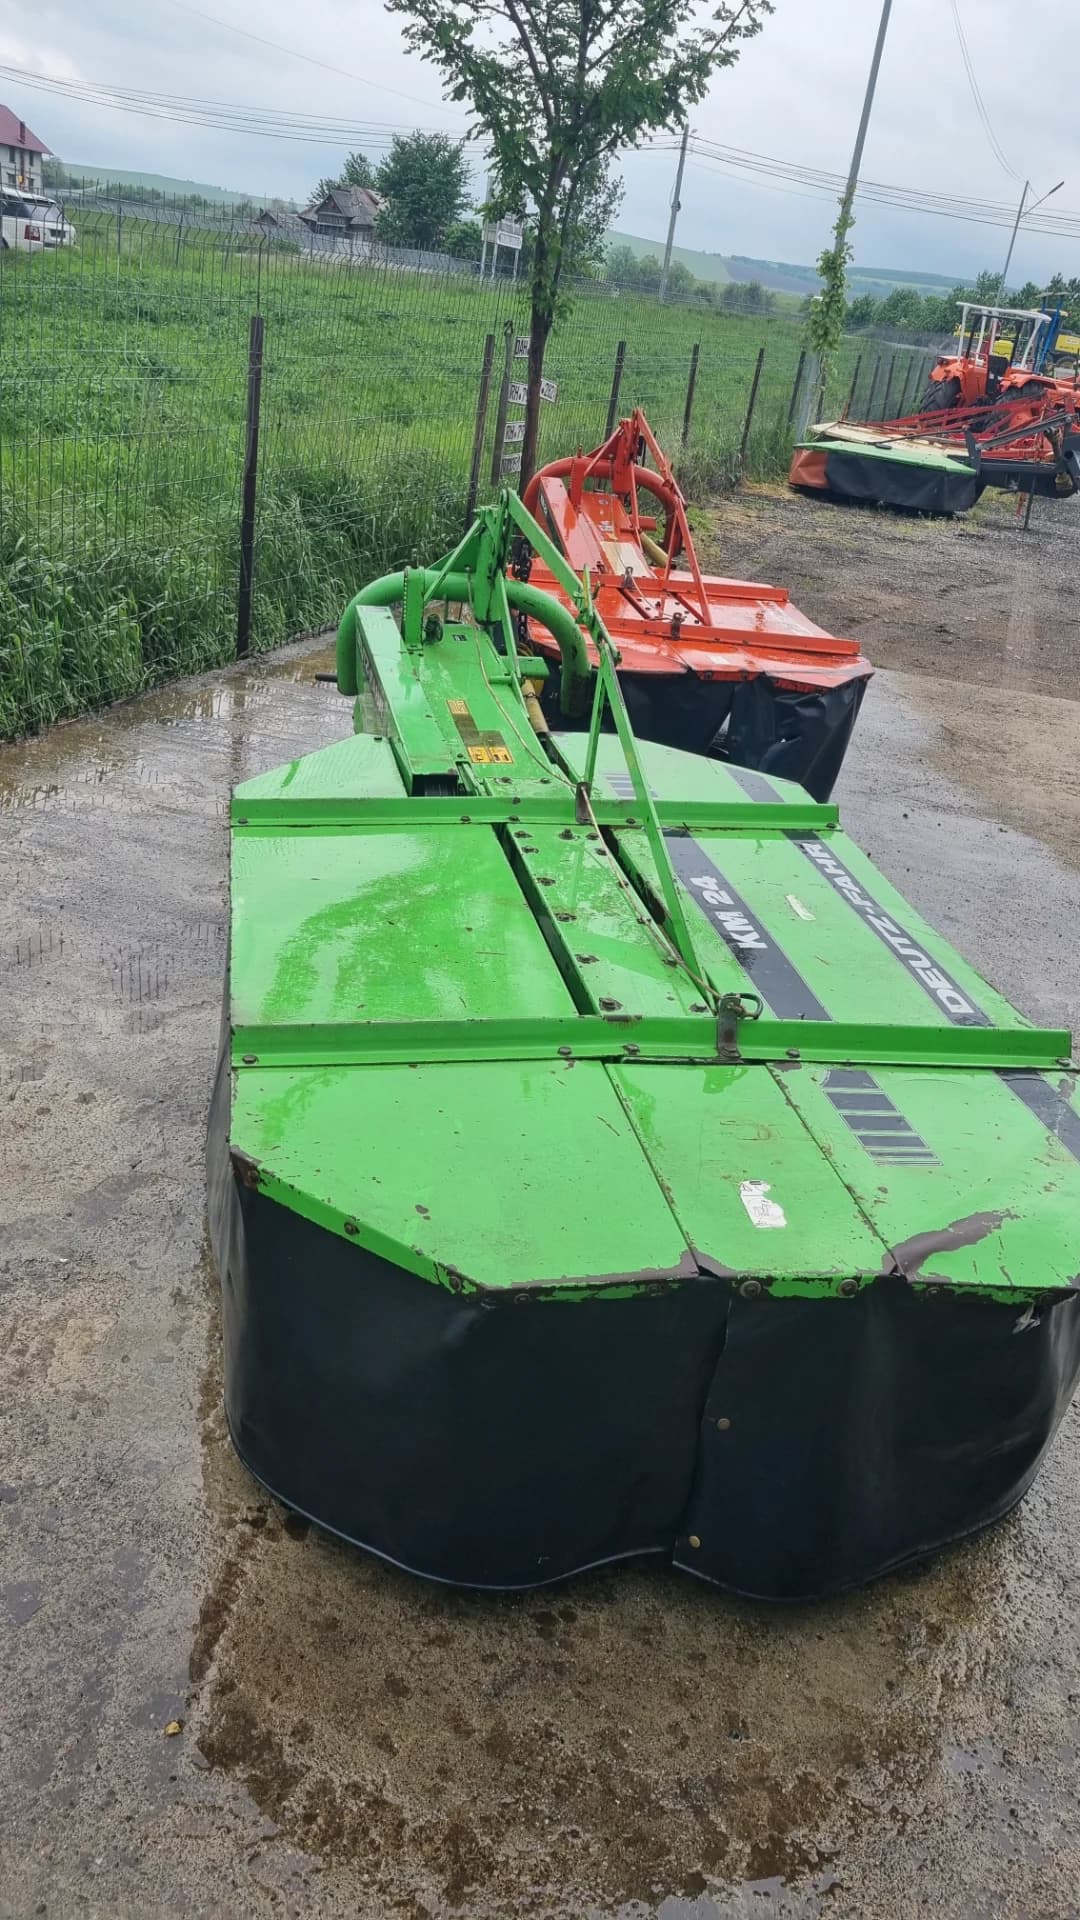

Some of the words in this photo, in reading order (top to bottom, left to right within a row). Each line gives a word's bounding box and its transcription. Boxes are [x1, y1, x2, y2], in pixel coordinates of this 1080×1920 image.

[689, 875, 735, 906] 24
[717, 911, 769, 949] KM
[801, 842, 976, 1014] DEUTZ-FAHR
